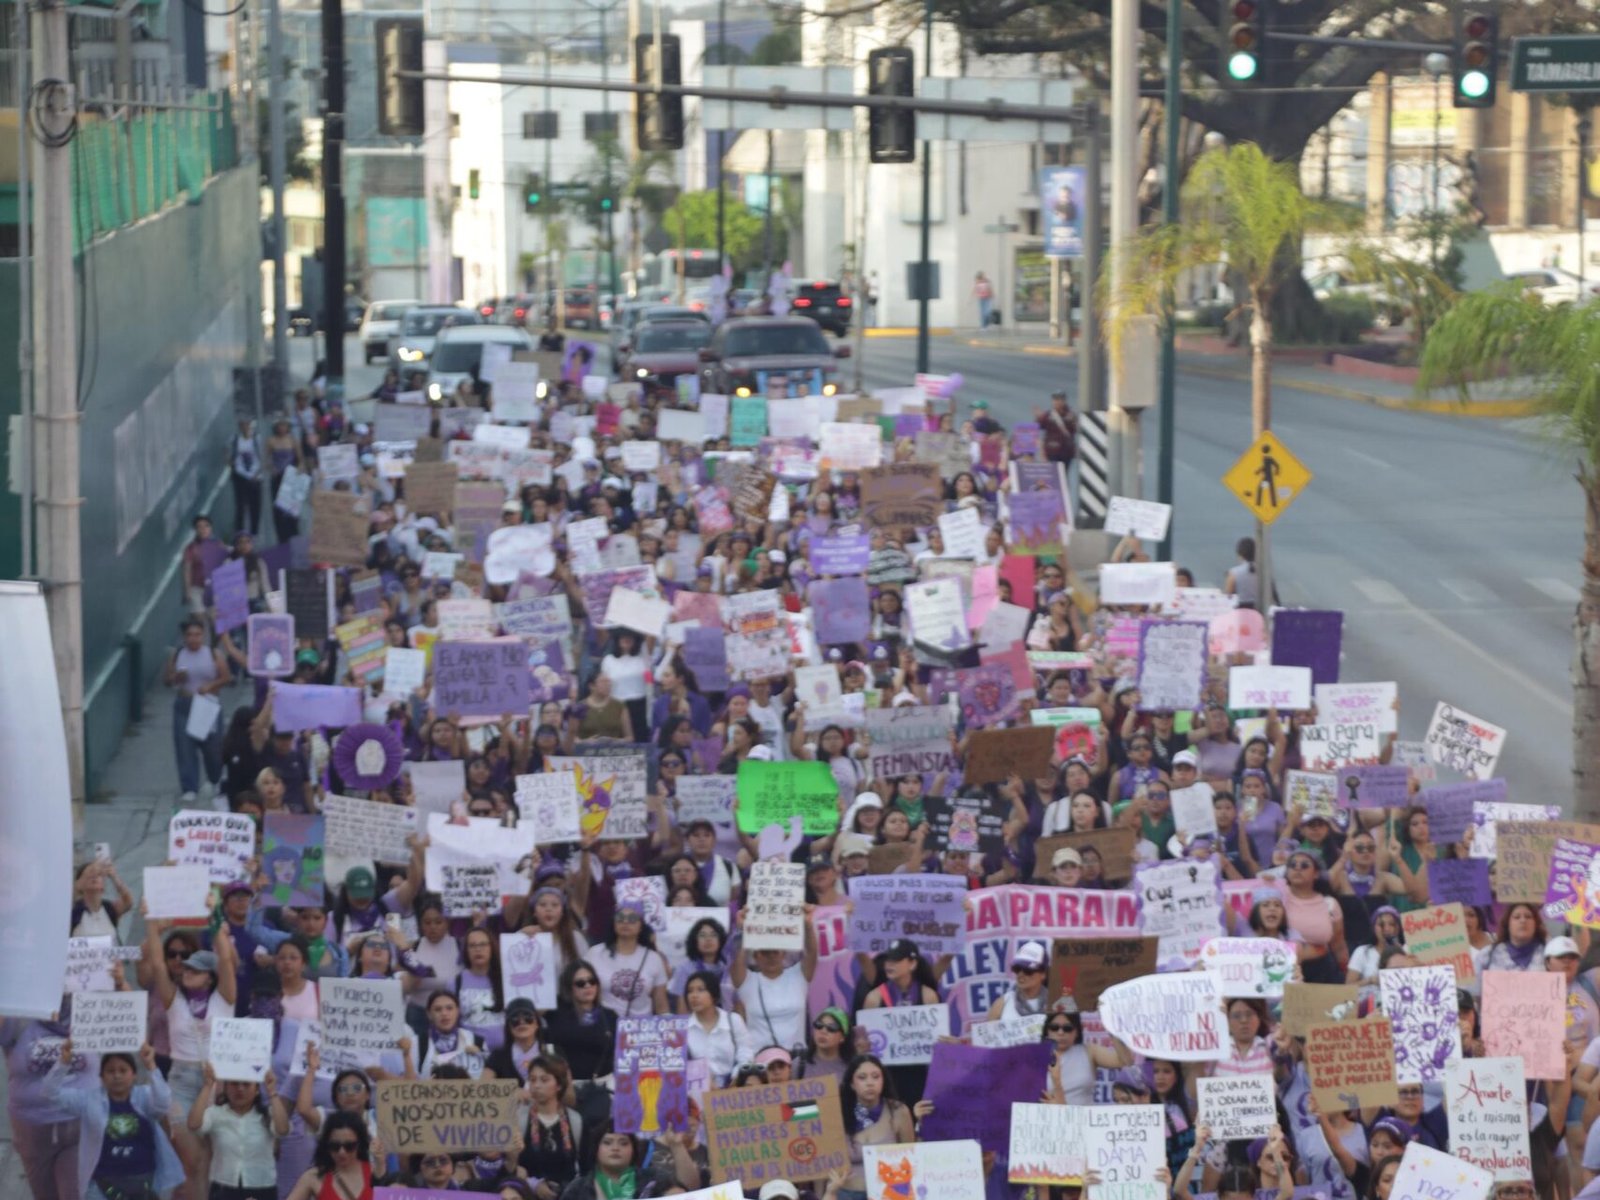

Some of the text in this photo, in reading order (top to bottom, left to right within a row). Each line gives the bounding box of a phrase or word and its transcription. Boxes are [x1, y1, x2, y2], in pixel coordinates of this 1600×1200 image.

[873, 751, 955, 778] FEMINISTA
[1011, 892, 1105, 928] PARA
[883, 1008, 939, 1031] JUNTAS
[711, 1087, 783, 1112] MUJERES
[1456, 1069, 1513, 1107] Amarte
[392, 1101, 499, 1124] NOSOTRAS
[1484, 1111, 1522, 1123] misma
[397, 1126, 425, 1146] DE
[717, 1119, 824, 1148] MUJERES EN
[1459, 1133, 1473, 1141] es
[1488, 1132, 1522, 1150] mayor
[1098, 1146, 1148, 1167] DAMA
